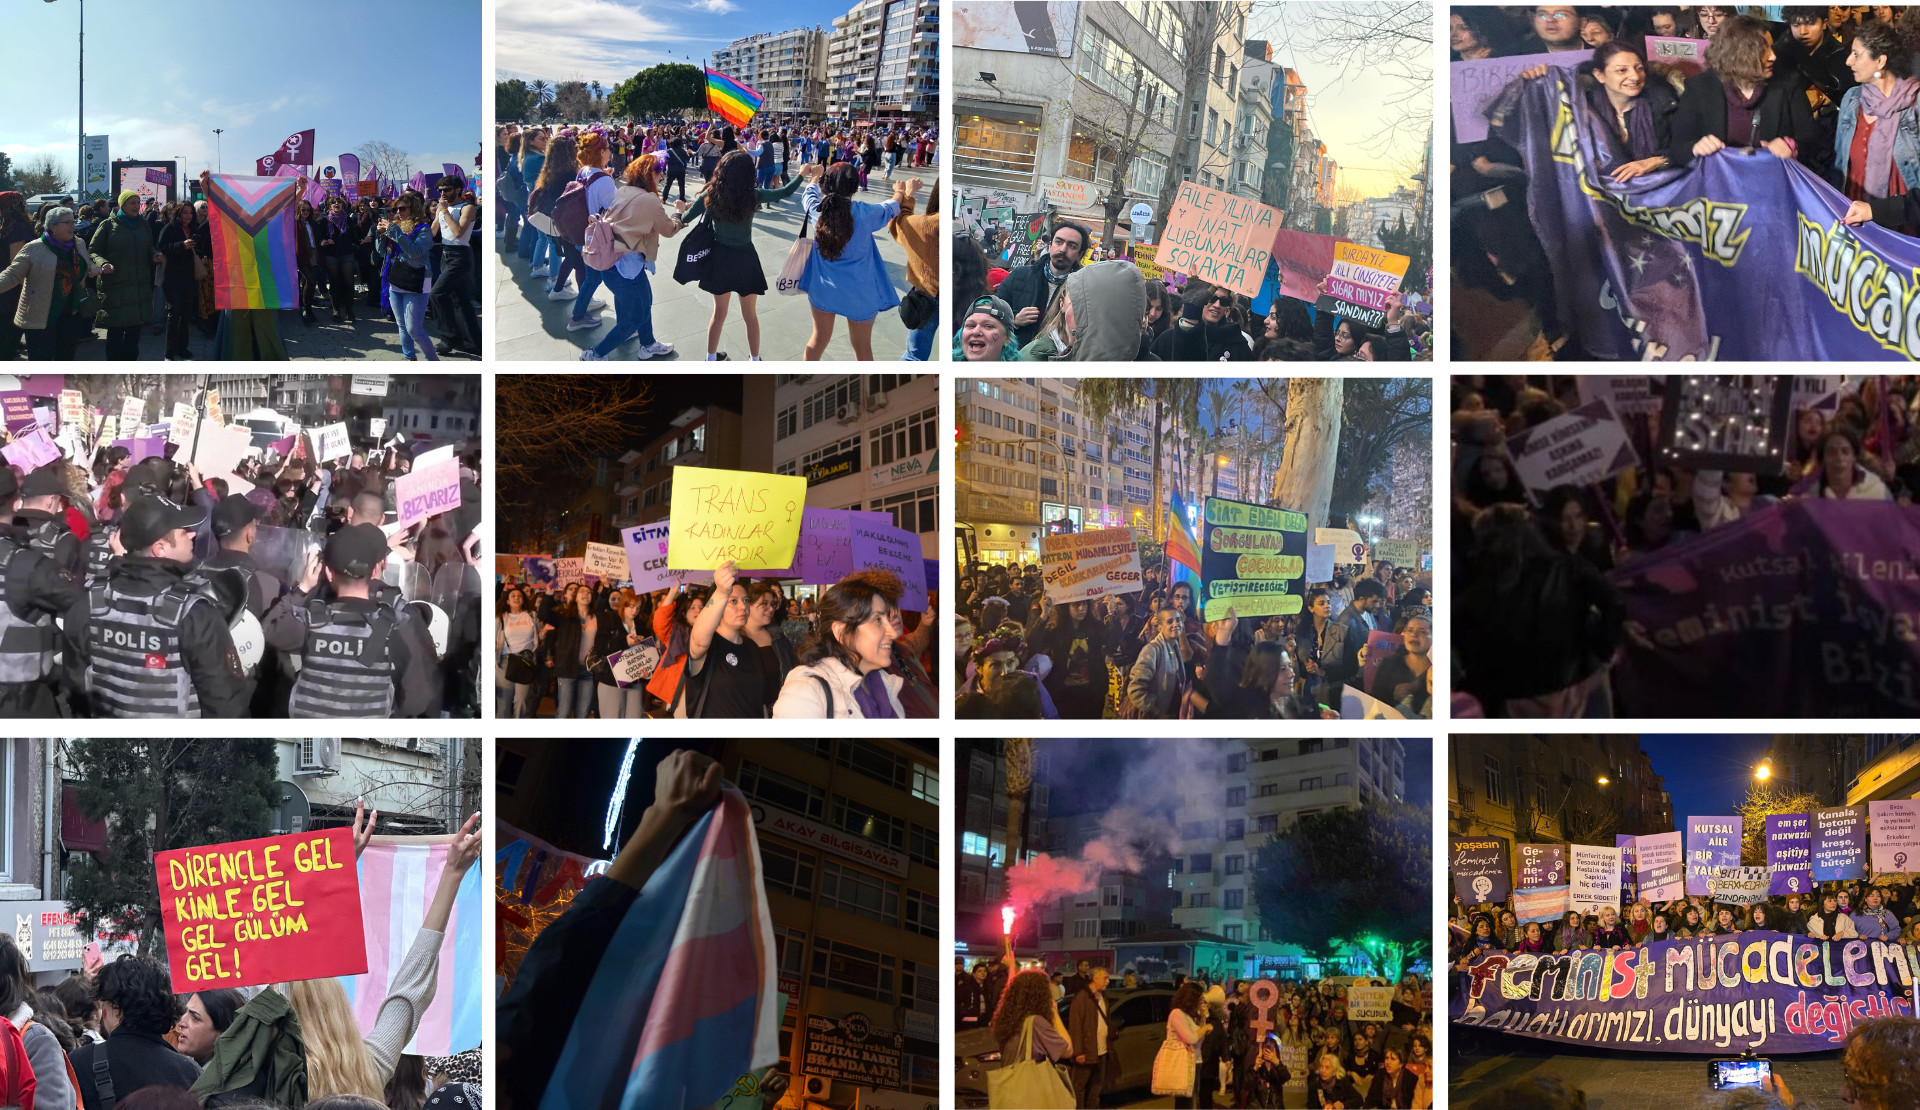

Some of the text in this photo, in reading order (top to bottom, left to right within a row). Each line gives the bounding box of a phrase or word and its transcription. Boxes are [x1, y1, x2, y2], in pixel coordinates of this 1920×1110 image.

[1179, 187, 1272, 228] AİLE YILINA
[1197, 213, 1242, 240] İNAT
[1167, 224, 1268, 271] LUBUNYALAR
[1135, 251, 1155, 262] FEMİNİS
[1166, 248, 1245, 288] SOKAKTA
[891, 458, 923, 477] NEVA
[690, 485, 769, 515] TRANS
[685, 520, 775, 543] KADINLAR
[701, 544, 767, 566] VARDIR
[1653, 591, 1818, 647] eminist
[103, 628, 161, 650] POLİS
[315, 638, 364, 656] POLİ
[1818, 808, 1858, 821] Kanala,
[1694, 824, 1734, 834] KUTSAL
[1792, 819, 1807, 829] şer
[1820, 818, 1857, 829] betona
[1824, 826, 1852, 837] değil
[773, 817, 899, 869] AKAY BİLGİSAYAR
[1454, 841, 1500, 852] yaşasın
[1708, 836, 1728, 846] AİLE
[1822, 839, 1855, 848] kreşe,
[1454, 850, 1500, 866] feminist
[1522, 846, 1543, 856] Ge-
[1695, 849, 1713, 860] BİR
[1816, 846, 1861, 859] sığınağa
[169, 837, 343, 890] DİRENÇLE GEL
[1601, 860, 1616, 868] değil
[1821, 857, 1856, 868] bütçe!
[1523, 866, 1542, 874] ne-
[1651, 867, 1668, 878] Hepsi
[1694, 865, 1721, 876] YALA
[1523, 875, 1542, 884] mi-
[1579, 880, 1612, 890] hiç değil!
[1641, 873, 1679, 890] erkek şiddeti!
[175, 880, 304, 922] KİNLE GEL
[181, 911, 308, 952] GEL GÜLÜM
[838, 1020, 866, 1034] NOKTA
[1663, 996, 1776, 1048] dünyayı
[806, 1053, 866, 1073] BRANDA
[862, 1052, 899, 1066] BASKI
